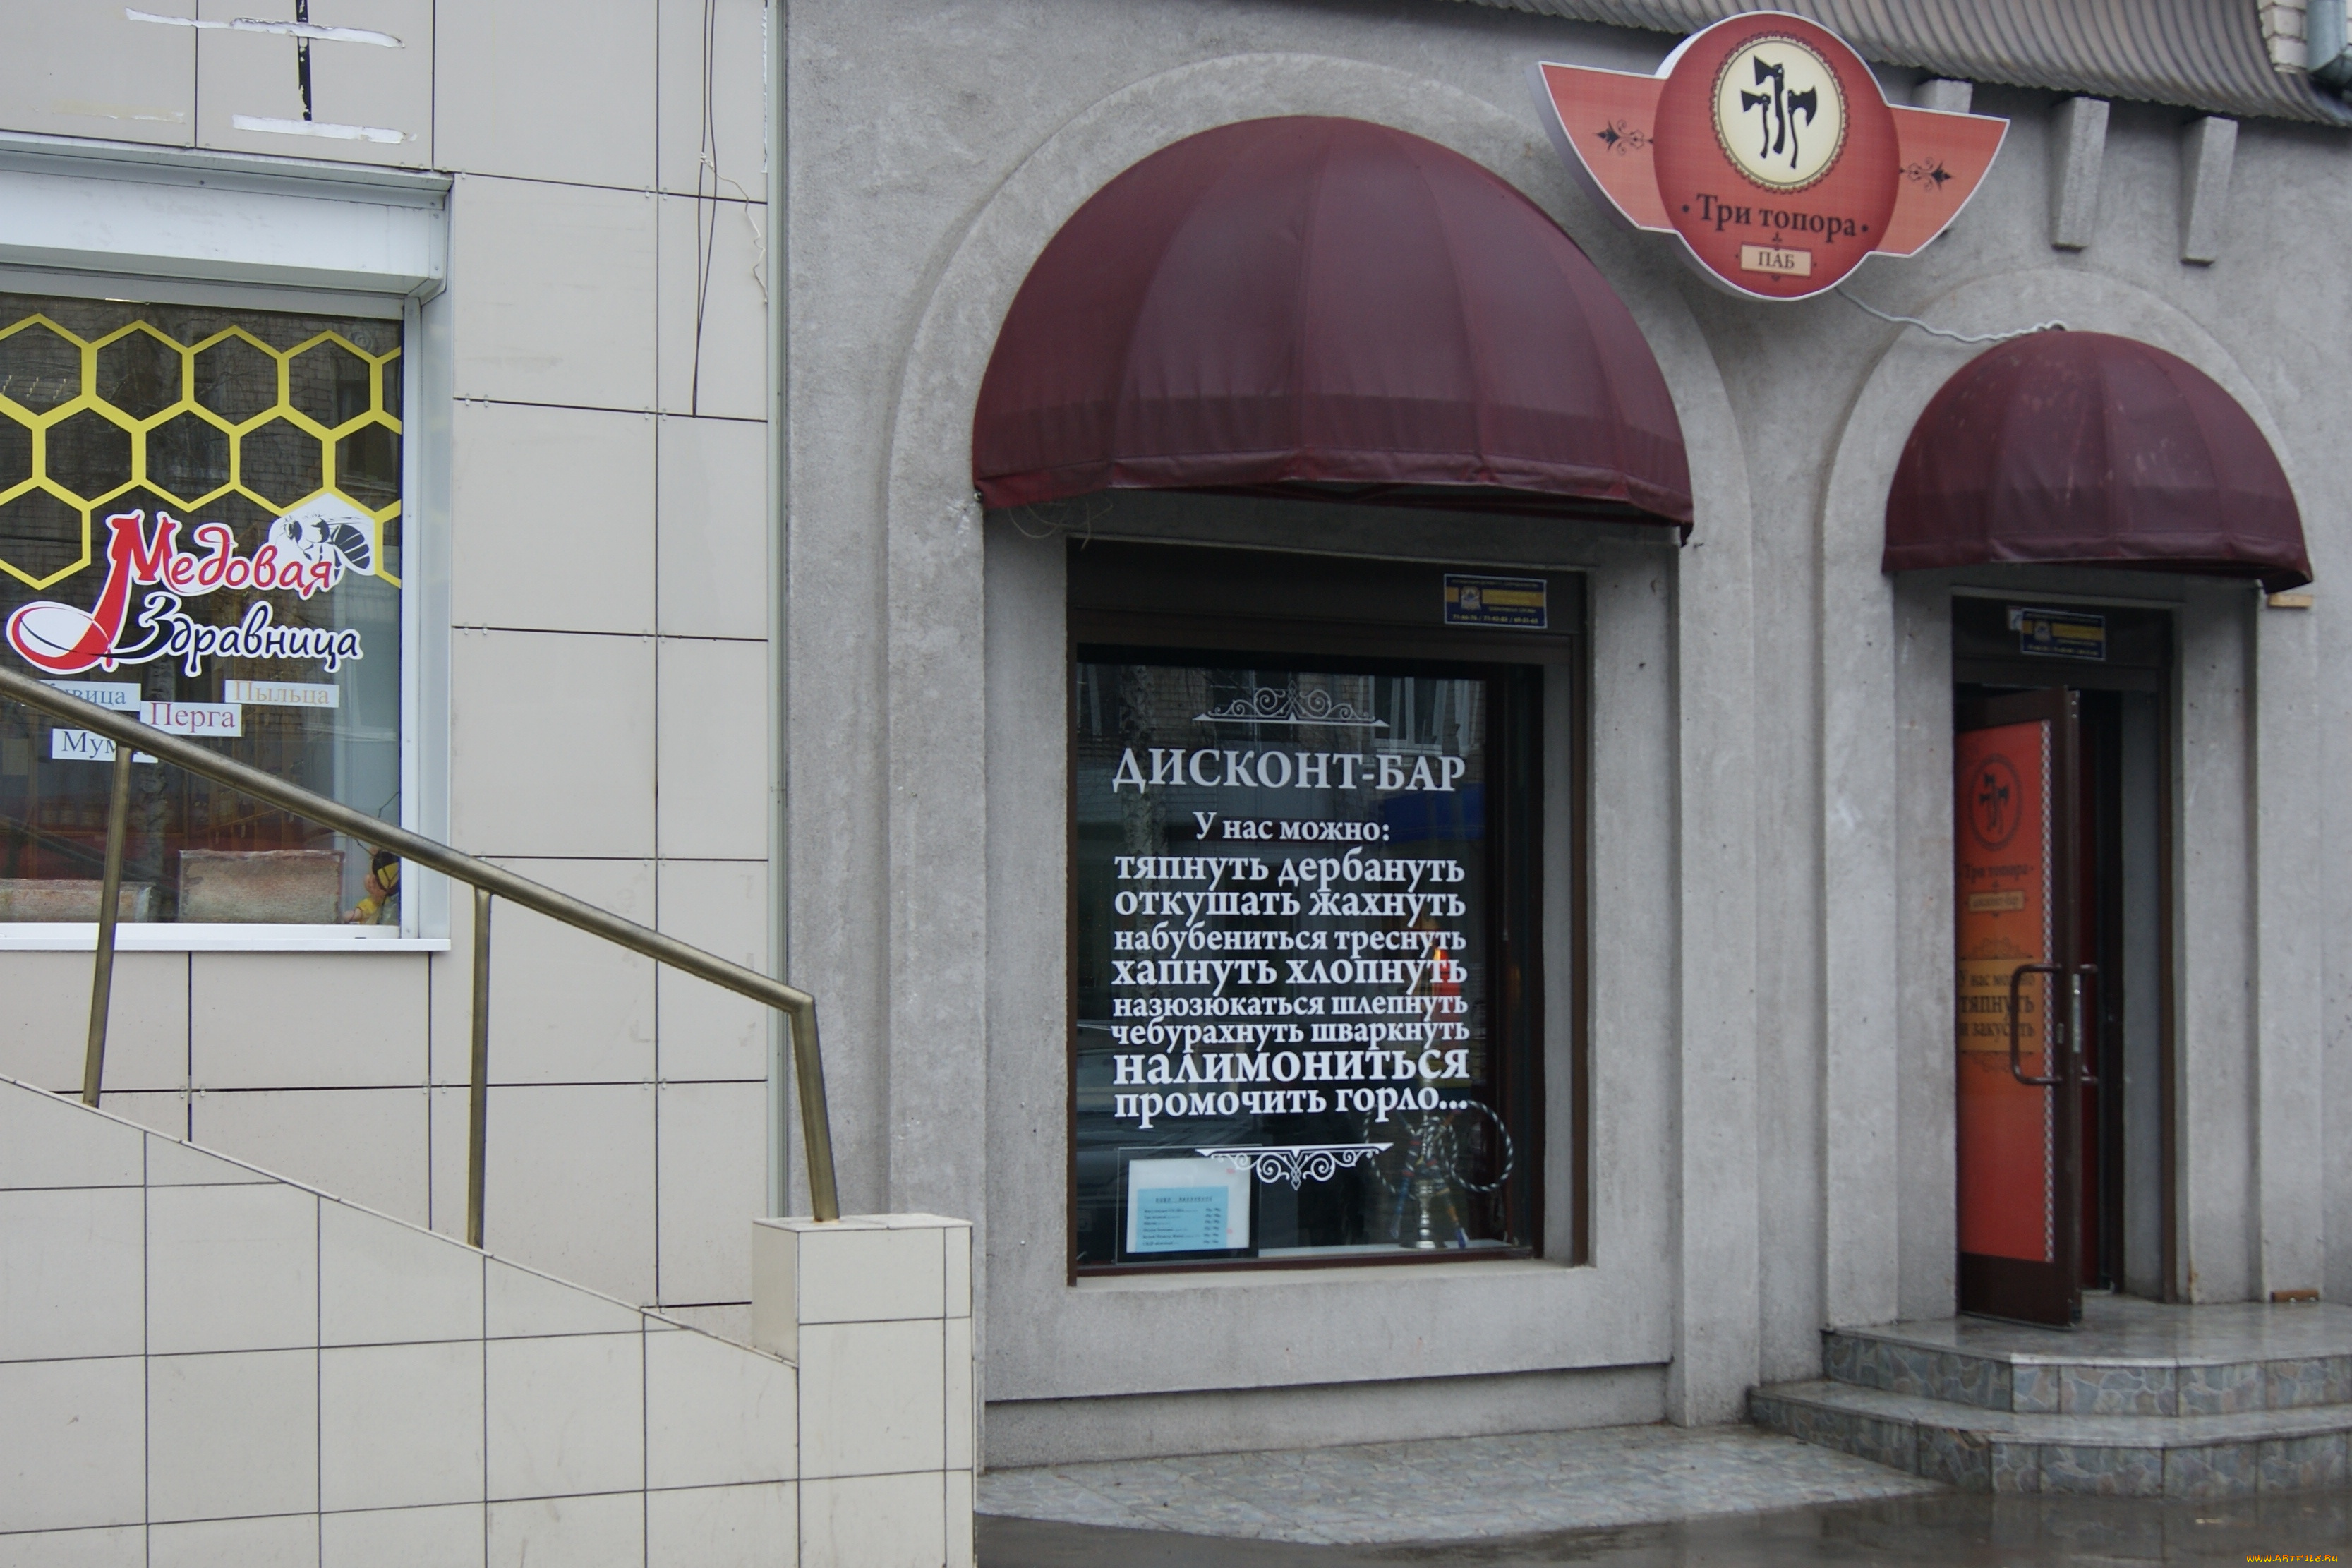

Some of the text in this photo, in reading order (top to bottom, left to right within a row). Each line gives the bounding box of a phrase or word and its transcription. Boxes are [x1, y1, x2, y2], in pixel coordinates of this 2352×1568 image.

[1696, 193, 1857, 243] Три топора
[1757, 251, 1795, 268] ПАБ
[106, 509, 335, 598] Медовая
[109, 593, 361, 675] Здравница
[49, 683, 126, 706] вица
[234, 680, 330, 704] Пыльца
[150, 702, 236, 733] Перга
[61, 730, 150, 759] Мум
[1112, 748, 1465, 793] ДИСКОНТ-БАР
[1193, 812, 1389, 841] У нас можно:
[1114, 846, 1465, 893] тяпнуть дербануть
[1115, 891, 1466, 928] откушать жахнуть
[1114, 921, 1467, 959] набубениться треснуть
[1111, 958, 1468, 996] хапнуть хлопнуть
[1994, 974, 2035, 986] моно
[1113, 996, 1468, 1022] назюзюкаться шлепнуть
[1111, 1015, 1470, 1053] чебурахнуть шваркнуть
[1972, 1022, 2035, 1042] закусть
[1113, 1049, 1470, 1085] налимониться
[1114, 1087, 1468, 1129] промочить горло...
